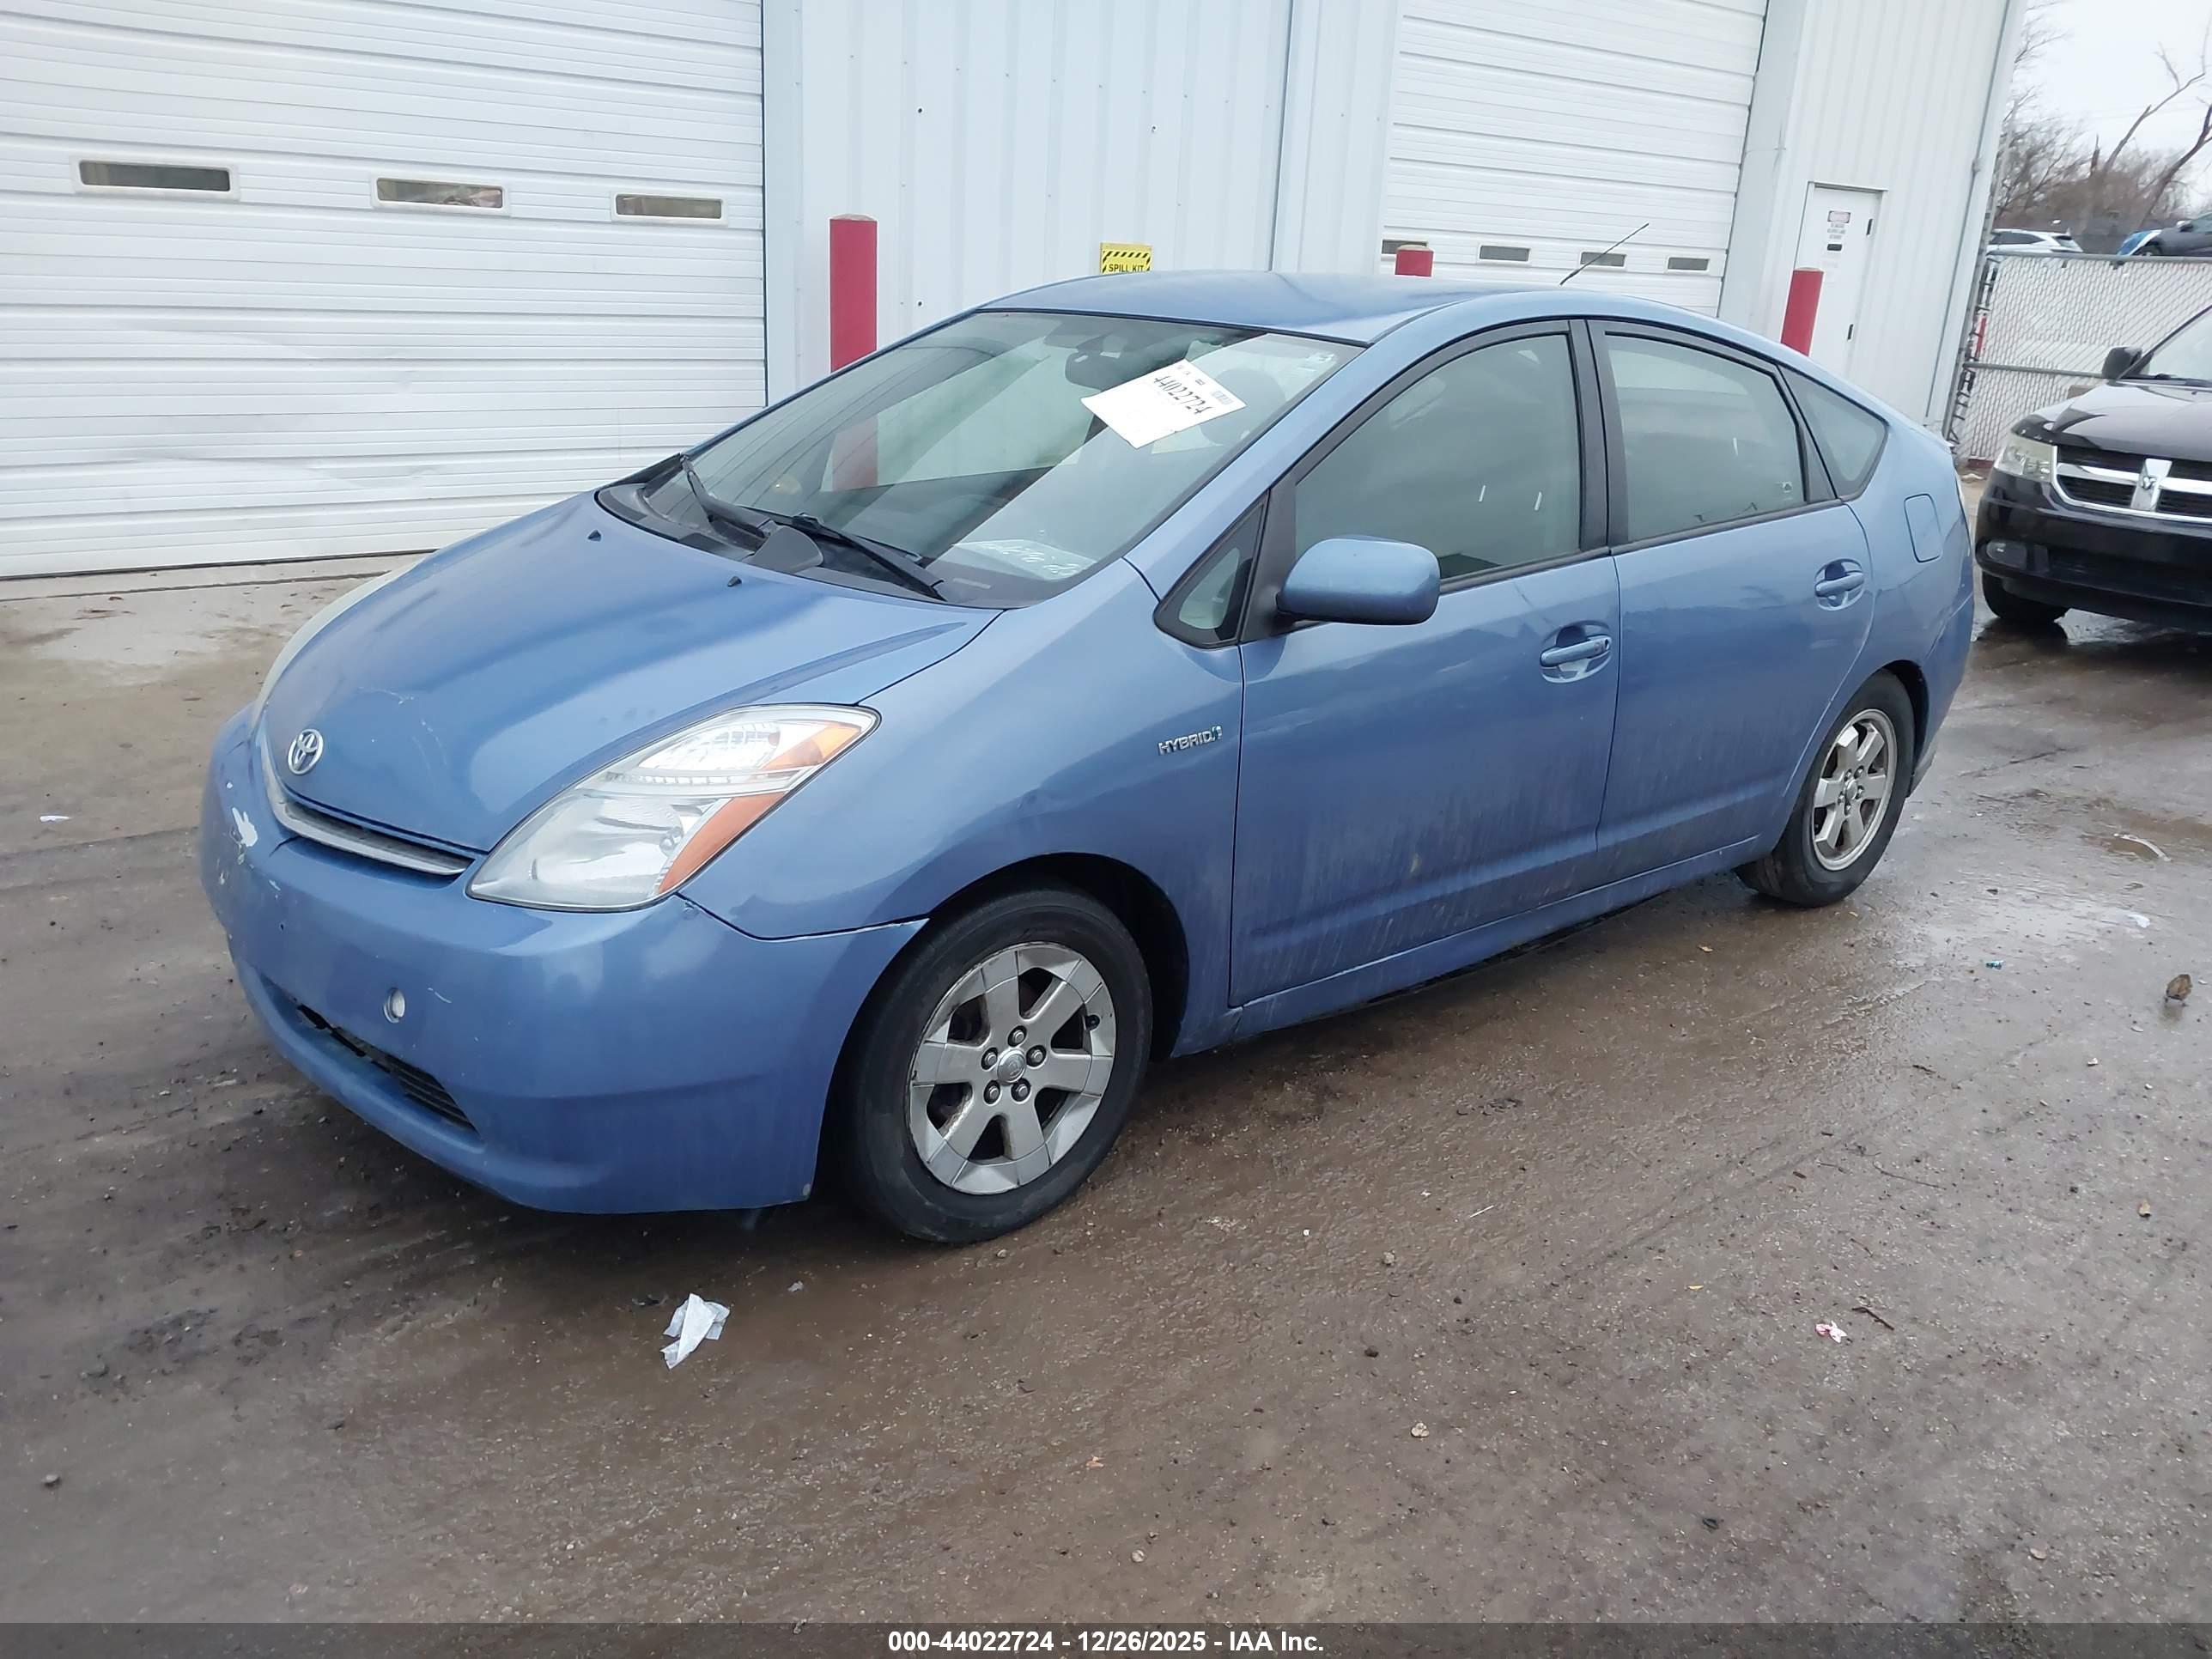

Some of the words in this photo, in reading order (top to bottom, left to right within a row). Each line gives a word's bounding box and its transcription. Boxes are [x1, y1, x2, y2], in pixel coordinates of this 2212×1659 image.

[1109, 264, 1129, 272] SPILL
[1153, 375, 1213, 416] 44022724
[1158, 731, 1212, 756] HYBRID
